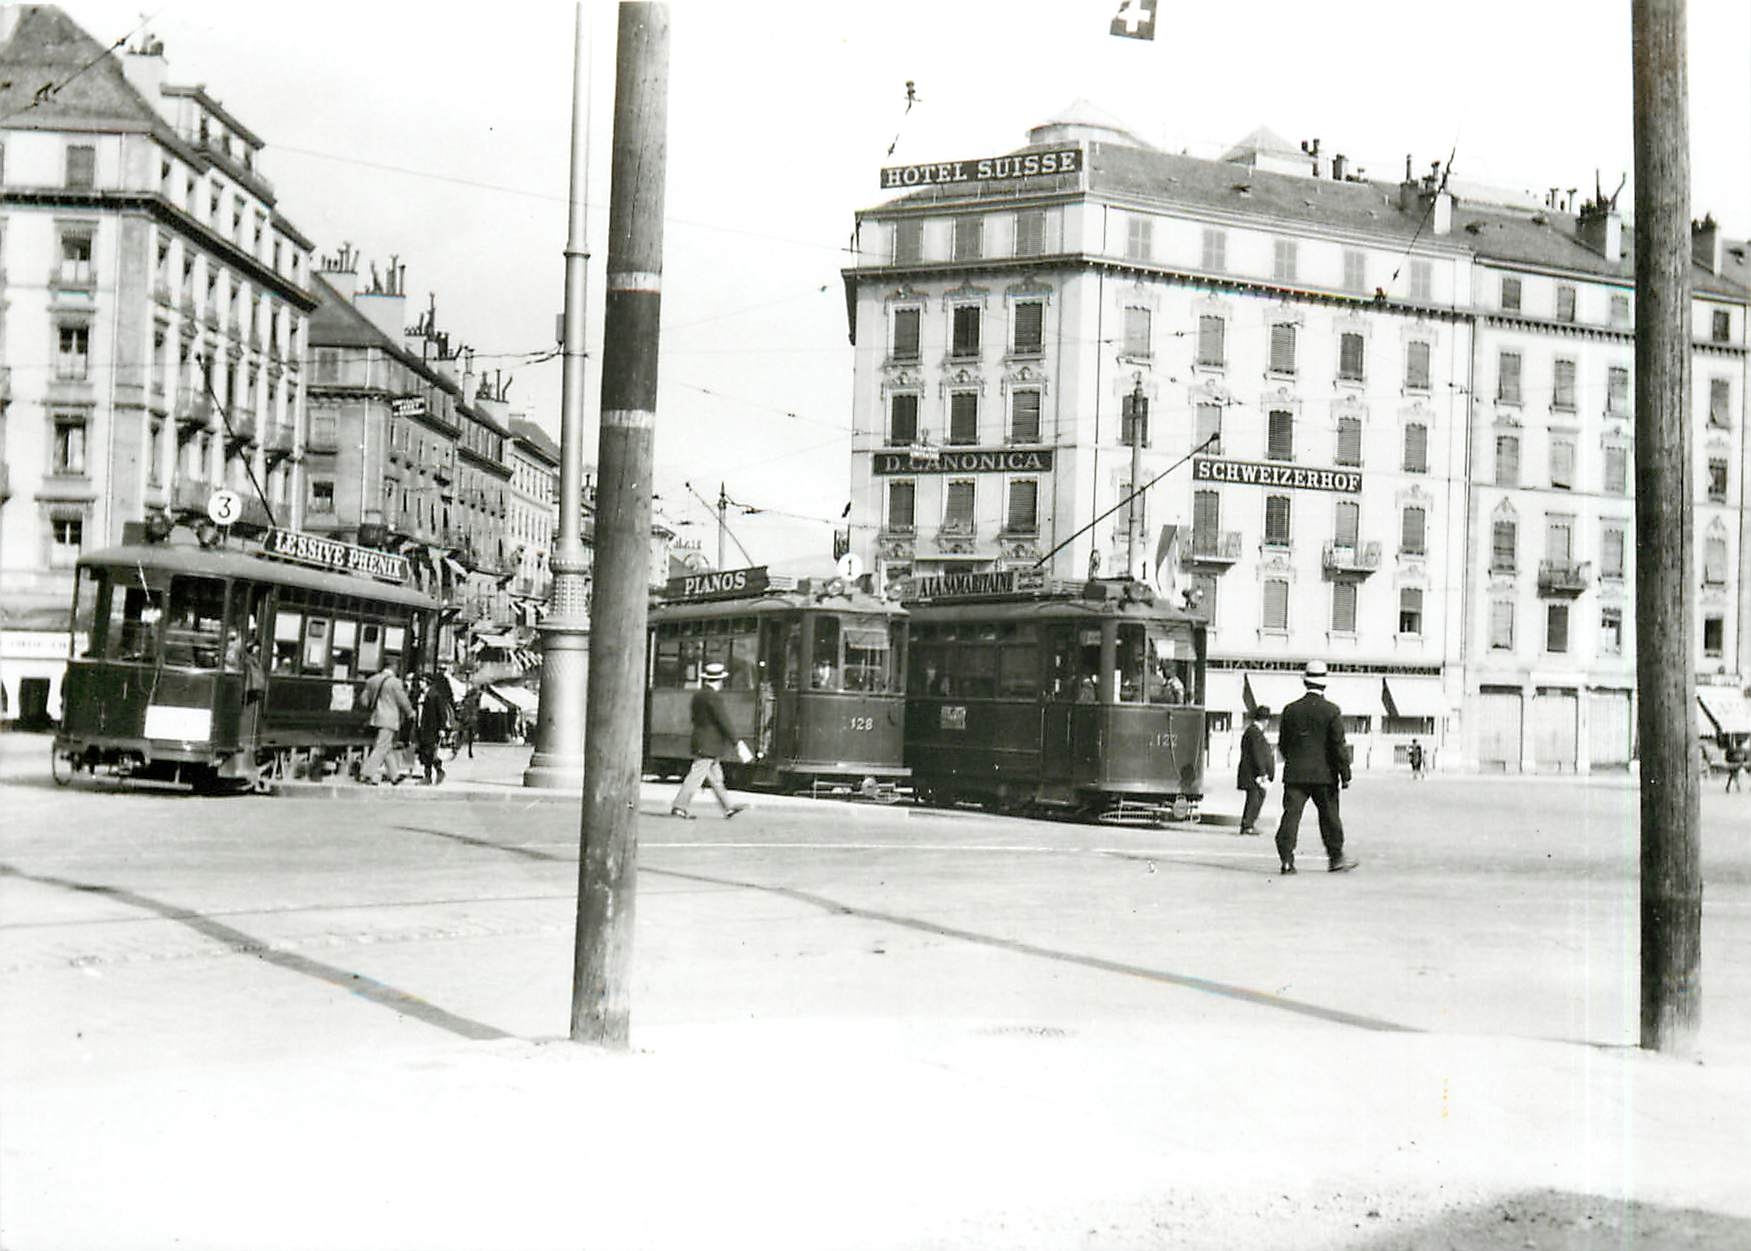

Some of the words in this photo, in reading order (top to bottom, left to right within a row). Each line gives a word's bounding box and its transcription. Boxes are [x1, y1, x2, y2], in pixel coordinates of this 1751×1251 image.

[886, 162, 968, 187] HOTEL
[977, 151, 1076, 179] SUISSE
[885, 458, 905, 471] D.
[1199, 461, 1360, 492] SCHWEIZERHOF
[218, 496, 231, 518] 3
[274, 530, 345, 567] LESSIVE
[683, 571, 747, 595] PIANOS
[850, 717, 873, 731] 128
